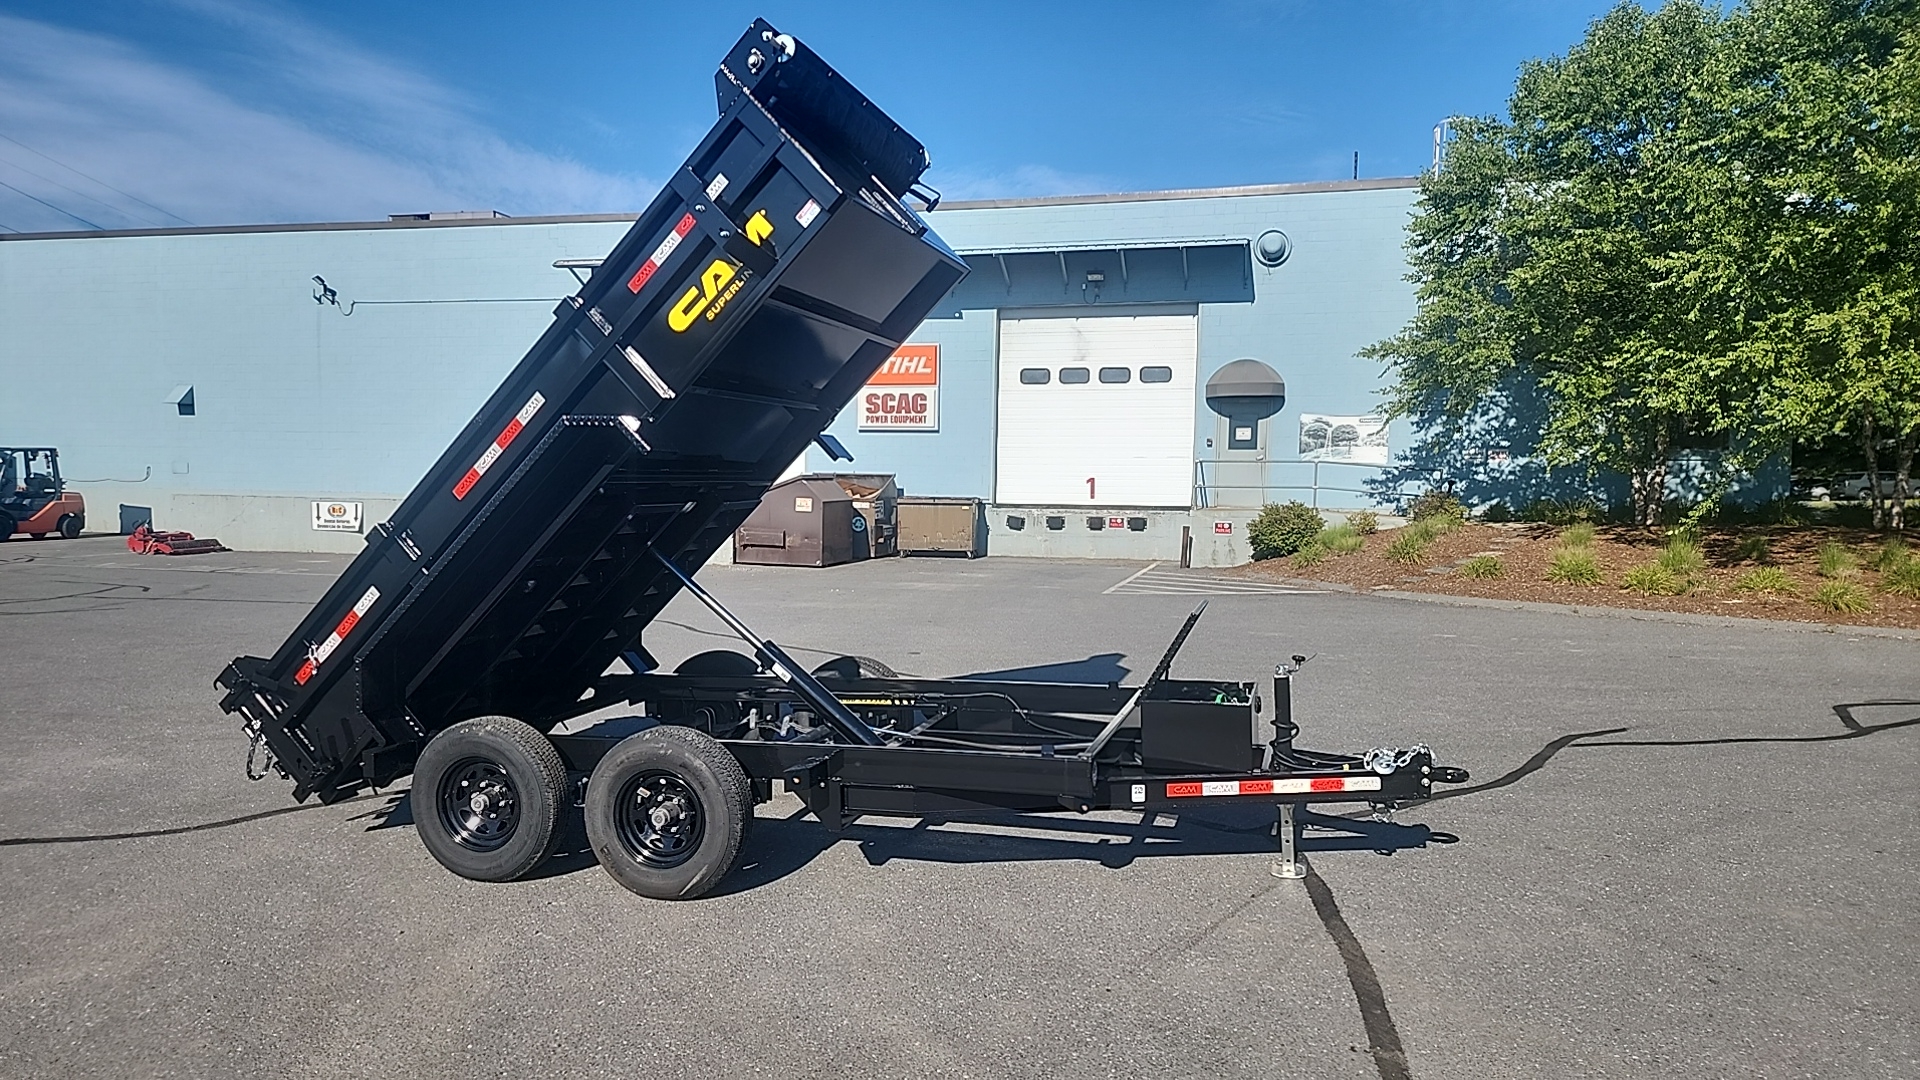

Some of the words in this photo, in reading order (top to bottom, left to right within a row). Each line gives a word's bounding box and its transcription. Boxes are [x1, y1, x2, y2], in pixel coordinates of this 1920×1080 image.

[634, 264, 652, 286] CAM
[657, 237, 677, 259] CAM
[706, 268, 753, 321] SUPERLIN
[880, 356, 932, 374] TIHL
[865, 393, 927, 414] SCAG
[865, 415, 888, 424] POWER
[890, 415, 927, 424] EQUIPMENT
[459, 472, 476, 493] CAM
[480, 447, 498, 469] CAM
[501, 423, 518, 443] CAM
[523, 397, 540, 418] CAM
[1085, 477, 1096, 500] 1
[321, 637, 337, 655] CAM
[340, 615, 356, 633] CAM
[359, 591, 375, 610] CAM
[1173, 786, 1197, 794] CAM
[1208, 785, 1232, 793] CAM
[1244, 783, 1268, 791] CAM
